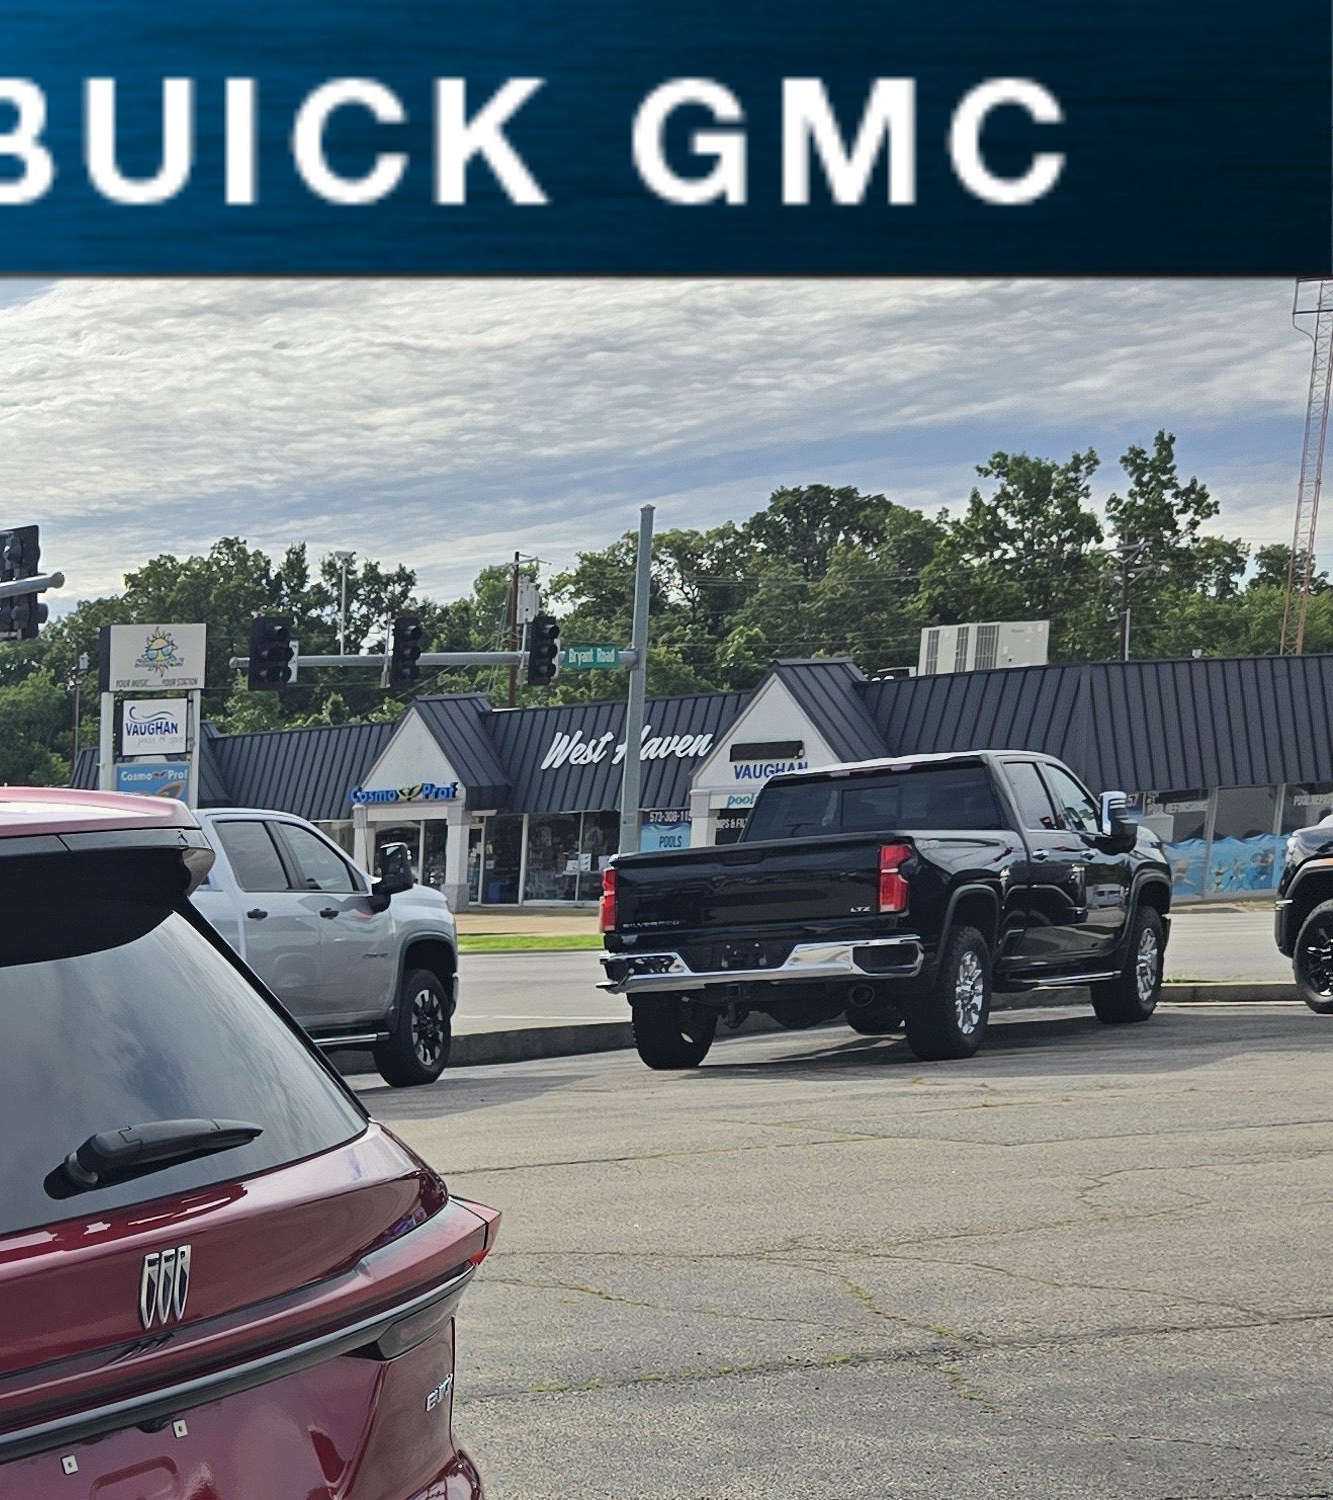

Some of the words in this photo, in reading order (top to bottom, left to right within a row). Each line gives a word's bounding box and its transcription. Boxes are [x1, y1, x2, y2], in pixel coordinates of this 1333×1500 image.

[568, 648, 594, 666] Bryant
[597, 648, 615, 663] Road
[125, 721, 179, 736] VAUGHAN
[541, 730, 614, 770] West
[121, 770, 153, 781] Cosmo
[167, 769, 189, 780] Prof
[349, 787, 399, 804] Cosmo
[421, 782, 458, 799] Prof
[725, 793, 758, 809] pool
[659, 835, 683, 848] POOLS
